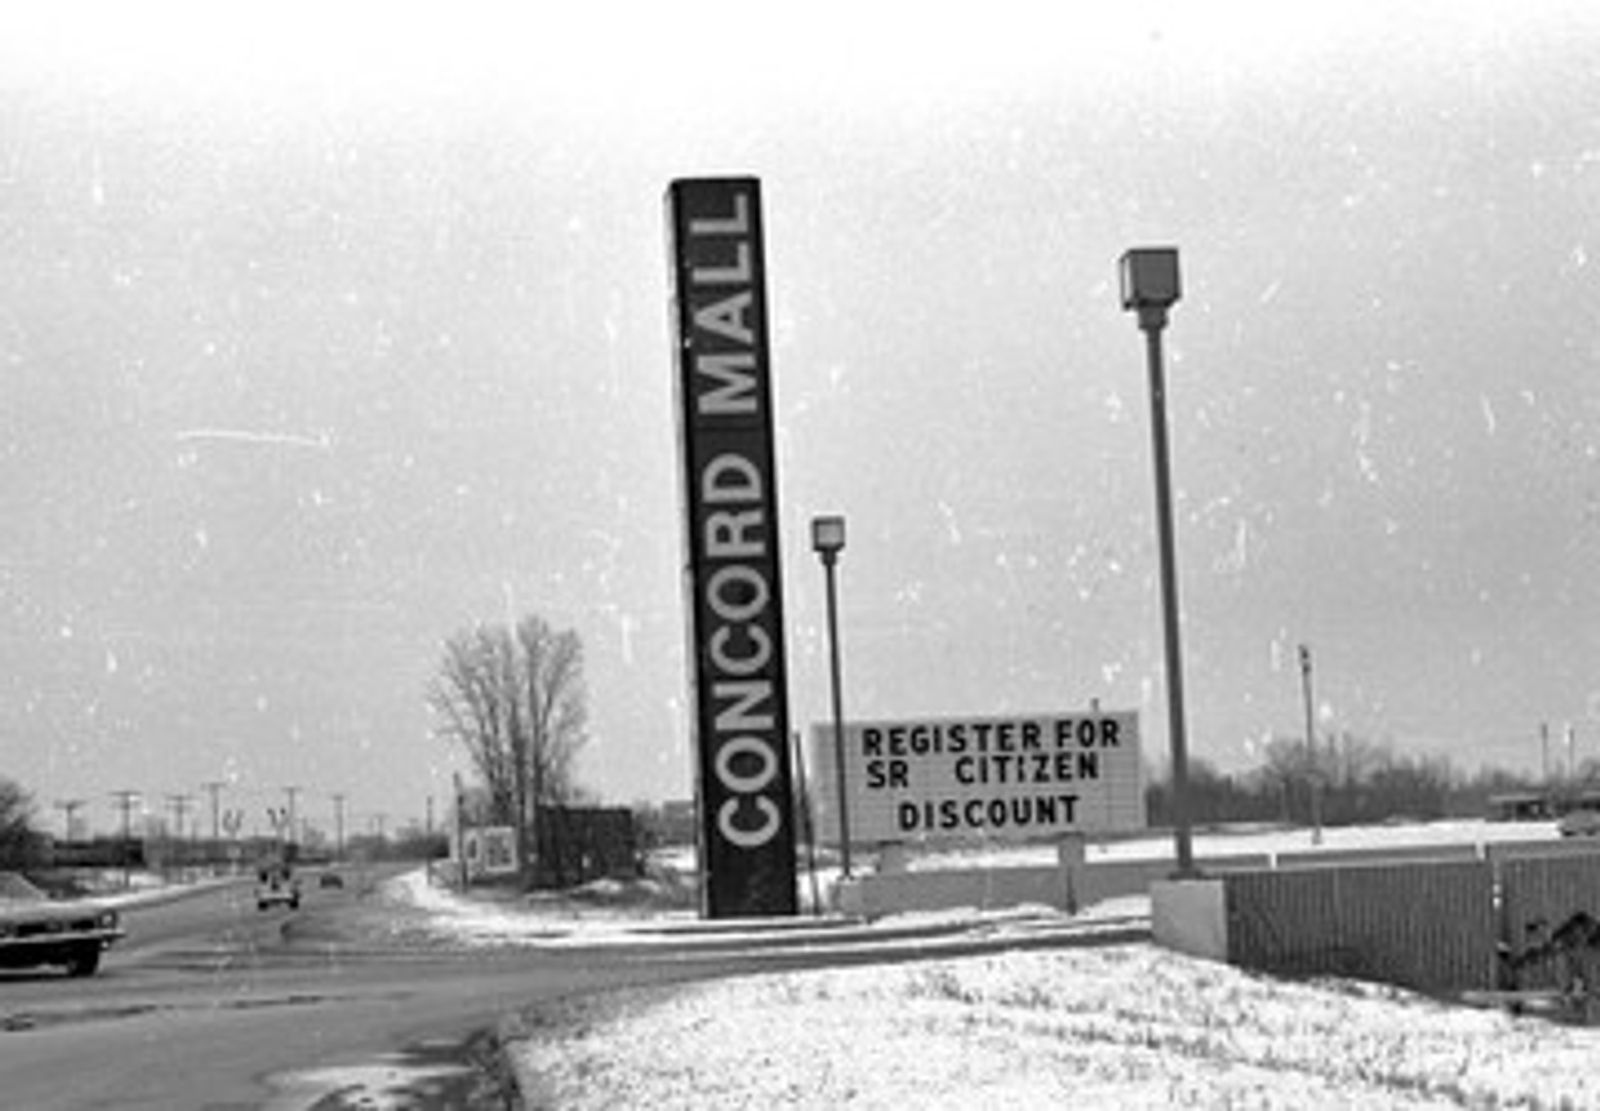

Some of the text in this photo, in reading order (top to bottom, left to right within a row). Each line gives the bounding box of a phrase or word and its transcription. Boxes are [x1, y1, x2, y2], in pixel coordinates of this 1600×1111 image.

[690, 194, 781, 847] CONCORD MALL
[862, 719, 1120, 756] REGISTER FOR
[866, 752, 1099, 789] SR CITIZEN
[899, 795, 1080, 831] DISCOUNT
